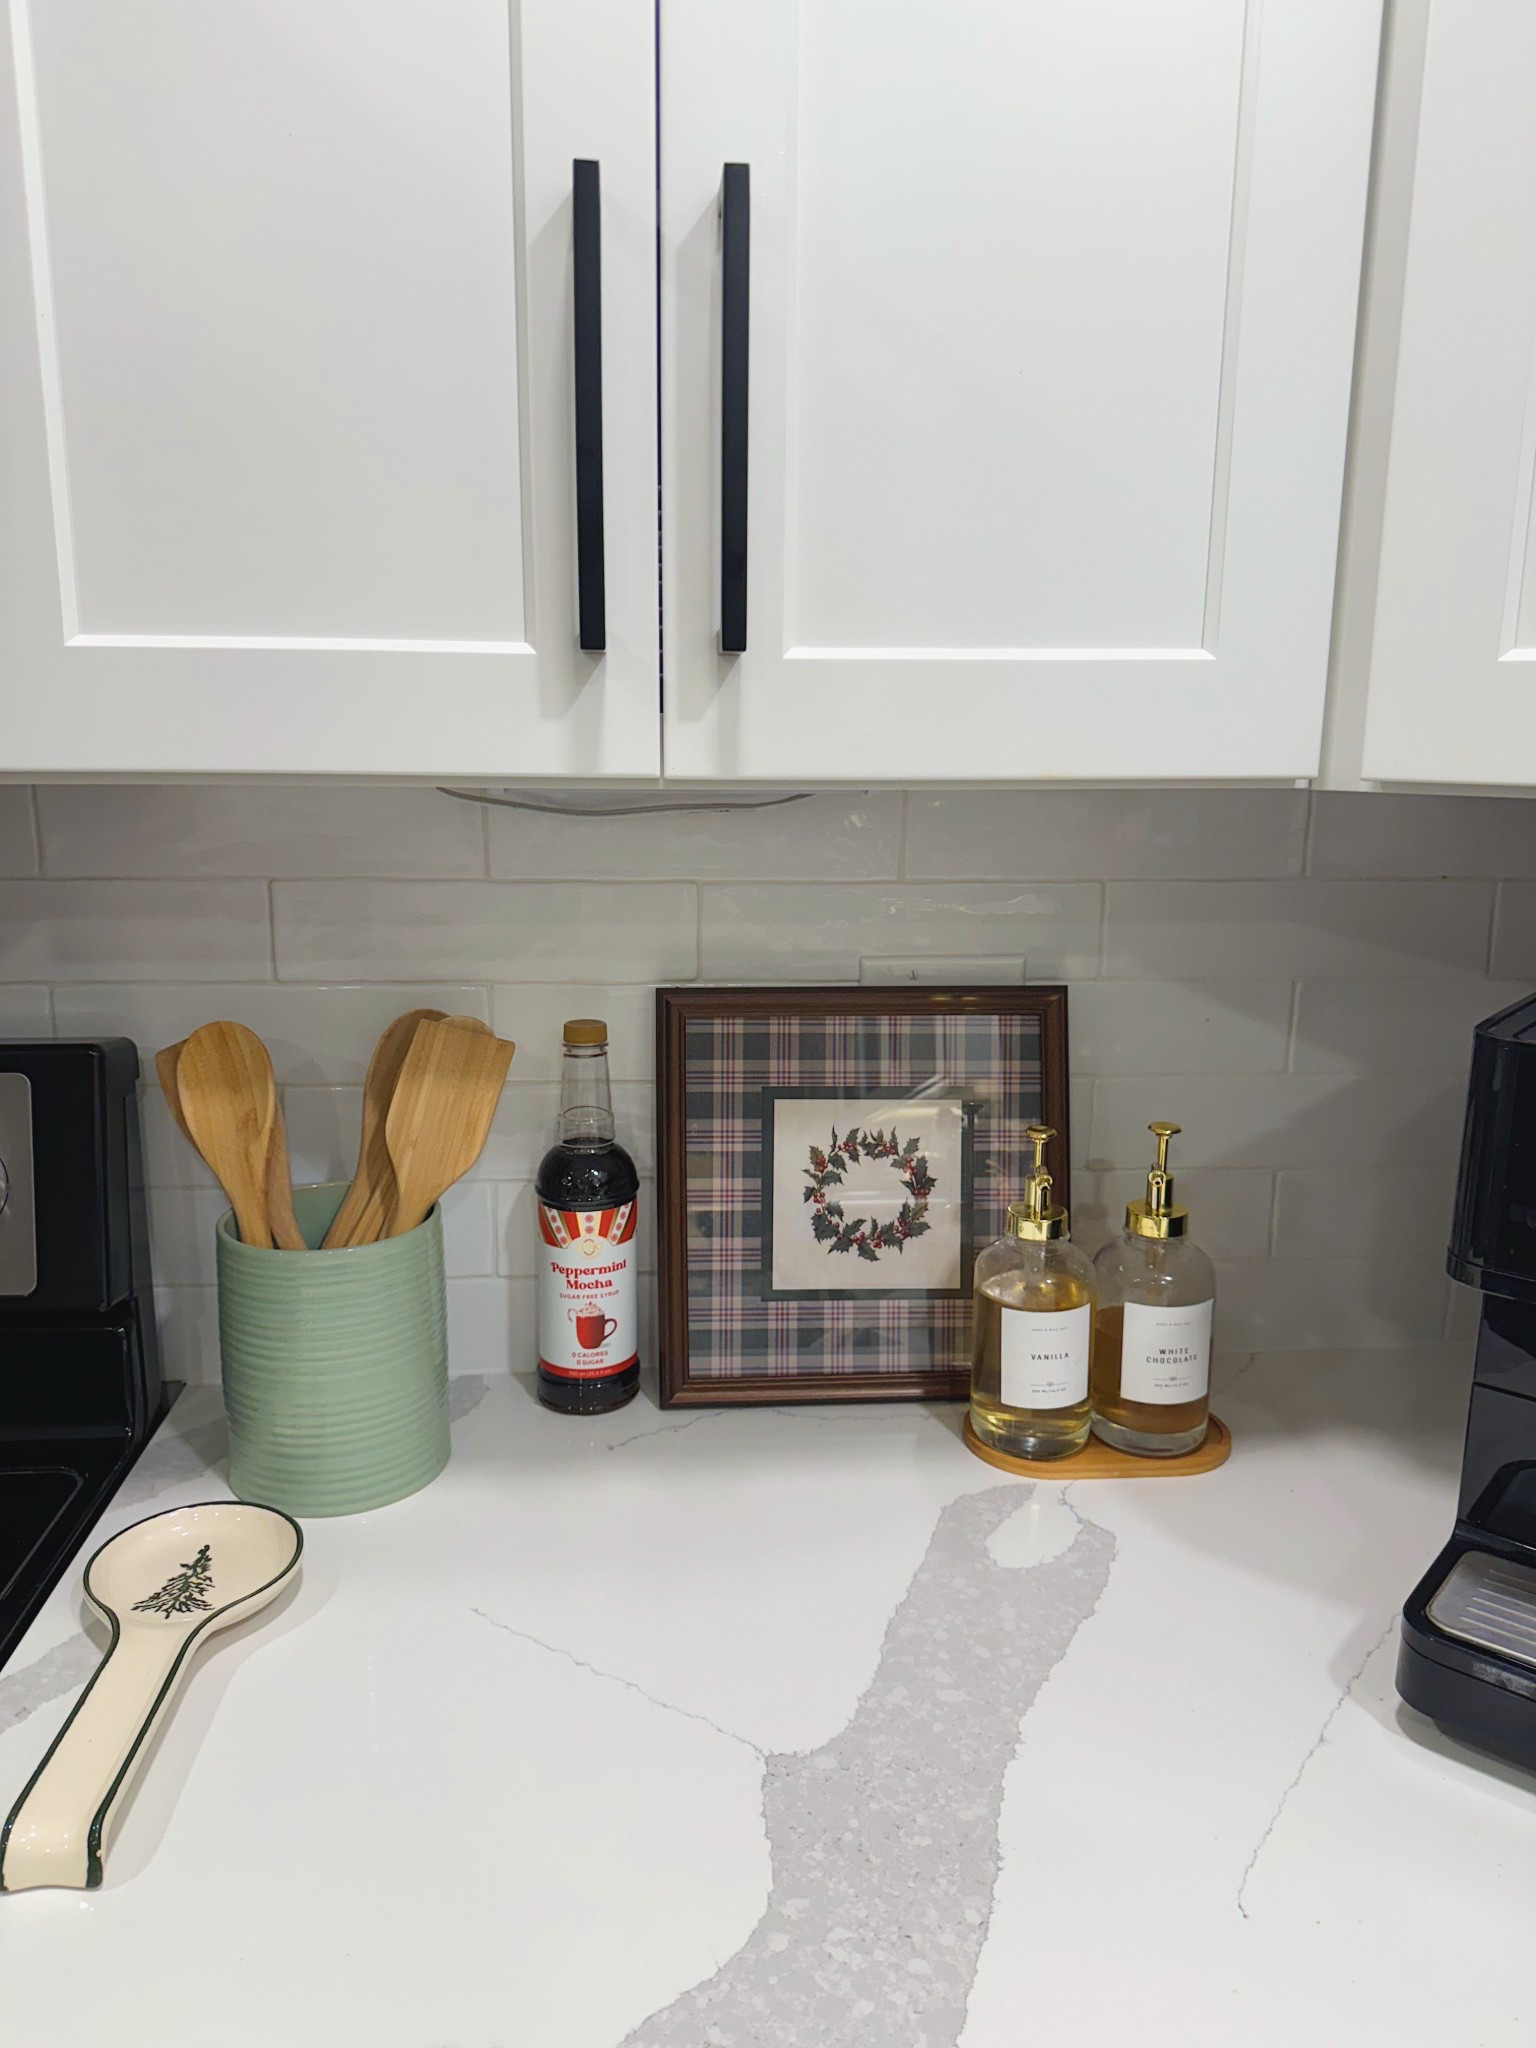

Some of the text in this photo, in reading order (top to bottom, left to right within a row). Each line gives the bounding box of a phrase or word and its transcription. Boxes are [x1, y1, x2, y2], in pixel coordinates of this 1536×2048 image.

[550, 1258, 627, 1278] Peppermint
[566, 1279, 613, 1290] Mocha
[600, 1290, 620, 1299] SYRUP
[578, 1350, 609, 1358] CALORIES
[1159, 1347, 1190, 1355] WHITE
[1030, 1352, 1070, 1361] VANILLA
[1146, 1353, 1198, 1364] CHOCOLATE
[582, 1358, 604, 1366] SUGAR
